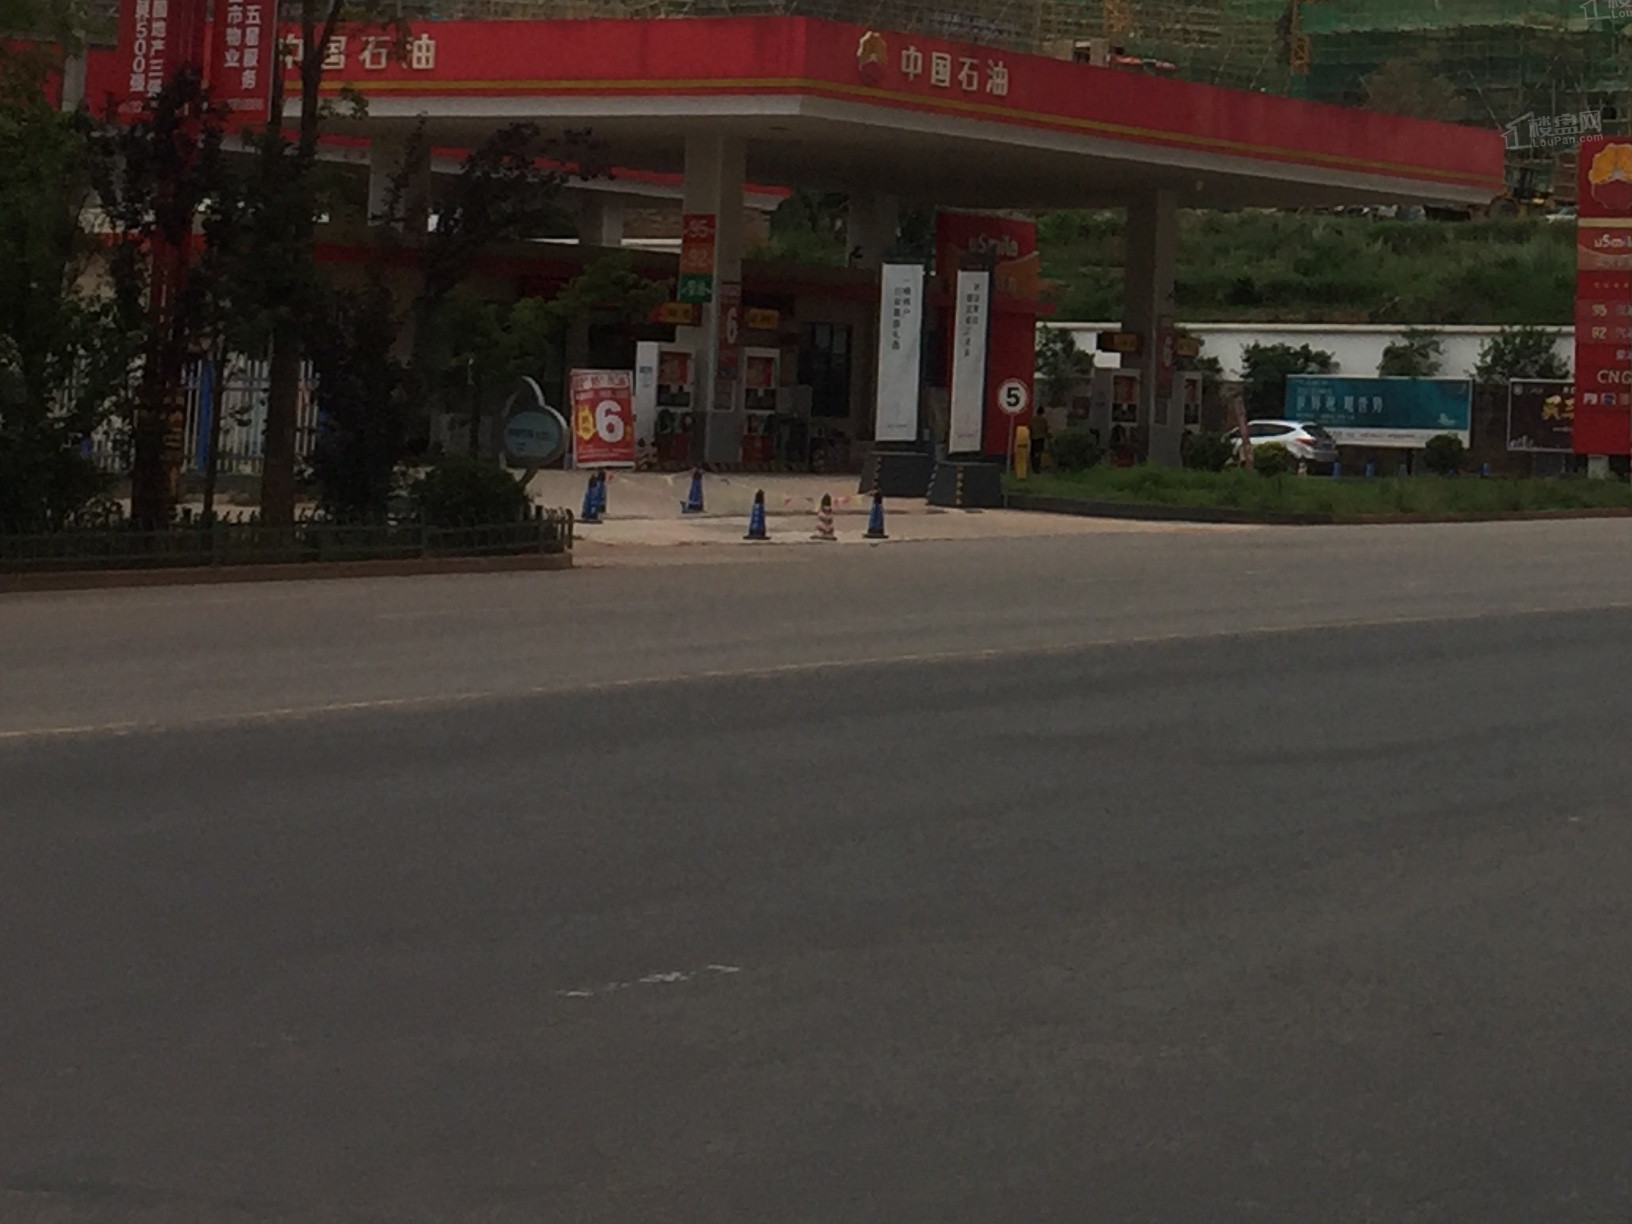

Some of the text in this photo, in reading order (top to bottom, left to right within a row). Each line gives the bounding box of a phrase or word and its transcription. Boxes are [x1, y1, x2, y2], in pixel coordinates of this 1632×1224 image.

[241, 4, 262, 90] 五星服务
[279, 32, 436, 70] 中国石油
[900, 45, 1009, 97] 中国石油
[1006, 387, 1020, 407] 5
[1596, 369, 1632, 384] CNG
[596, 399, 625, 443] 6
